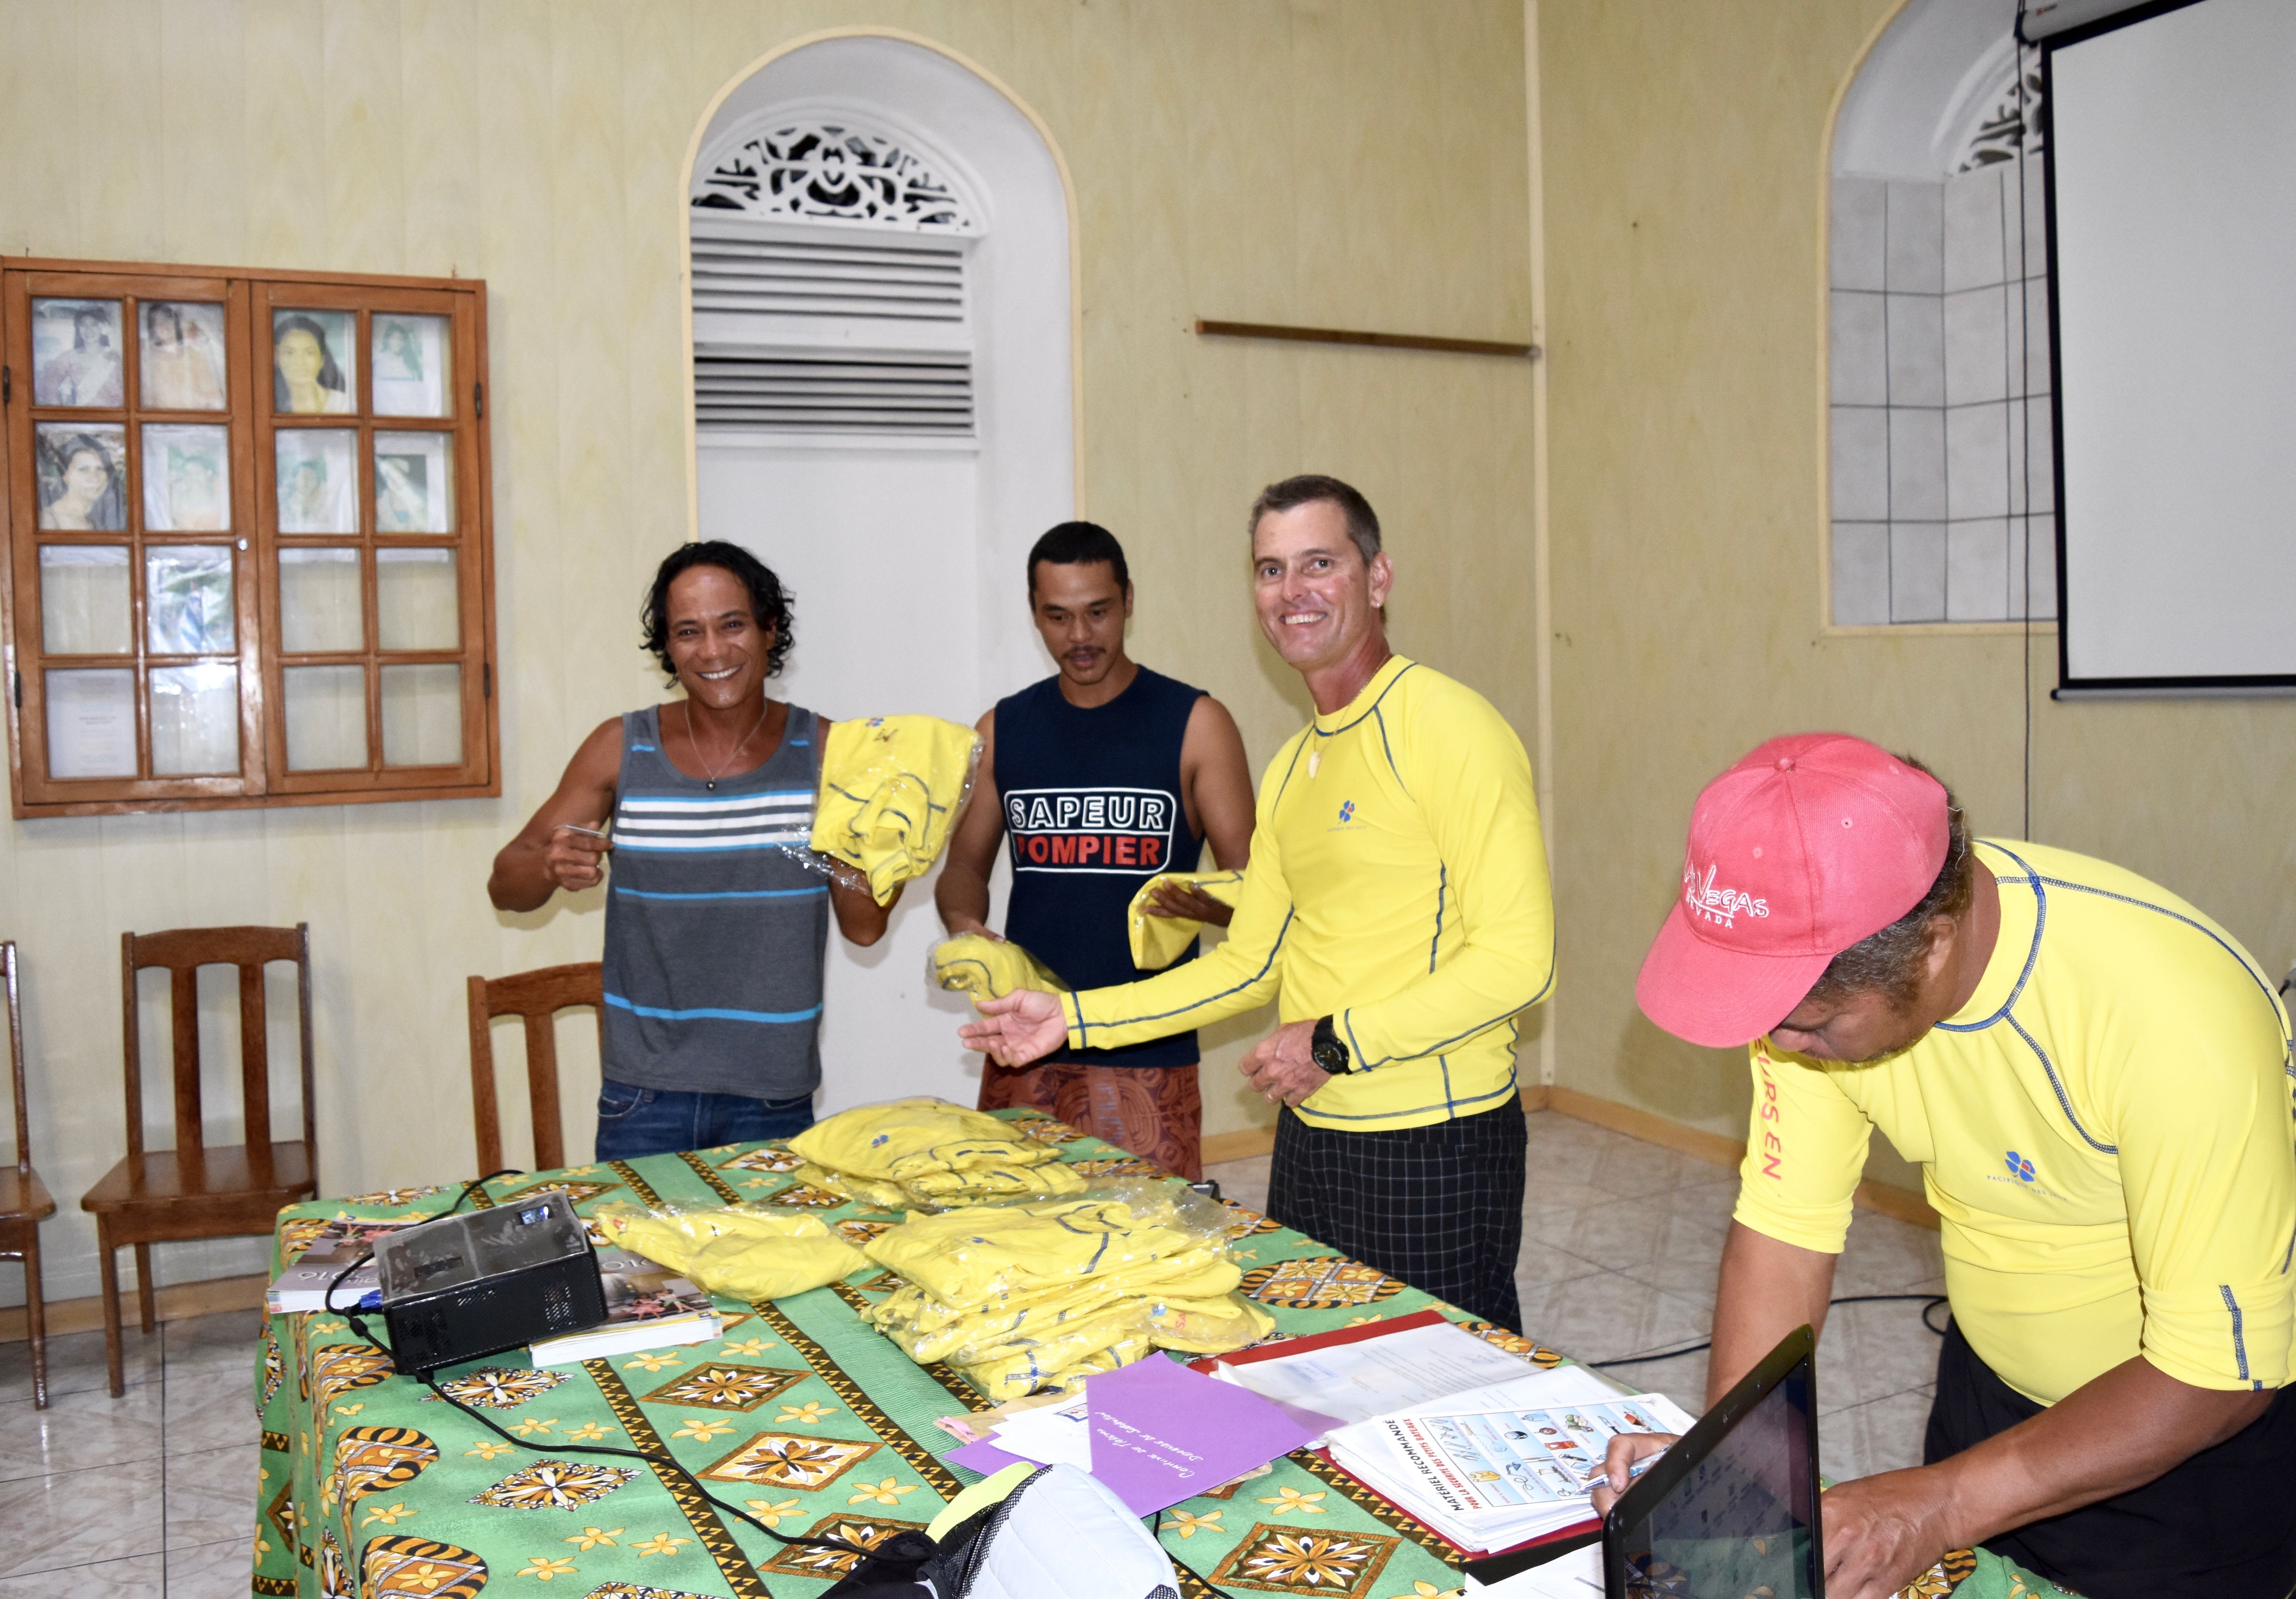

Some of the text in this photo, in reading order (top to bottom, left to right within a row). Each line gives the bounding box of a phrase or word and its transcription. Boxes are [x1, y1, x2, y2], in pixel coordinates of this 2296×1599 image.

[1010, 796, 1164, 829] SAPEUR
[1697, 864, 1769, 918] VEGAS
[1762, 1132, 1781, 1181] EN
[1402, 1418, 1425, 1441] BATEAUX
[1383, 1419, 1433, 1474] RECOMMANDÉ
[1419, 1442, 1437, 1458] PETITS
[1431, 1458, 1446, 1467] DES
[1427, 1475, 1465, 1511] MATÉRIEL
[1464, 1496, 1482, 1509] POUR
